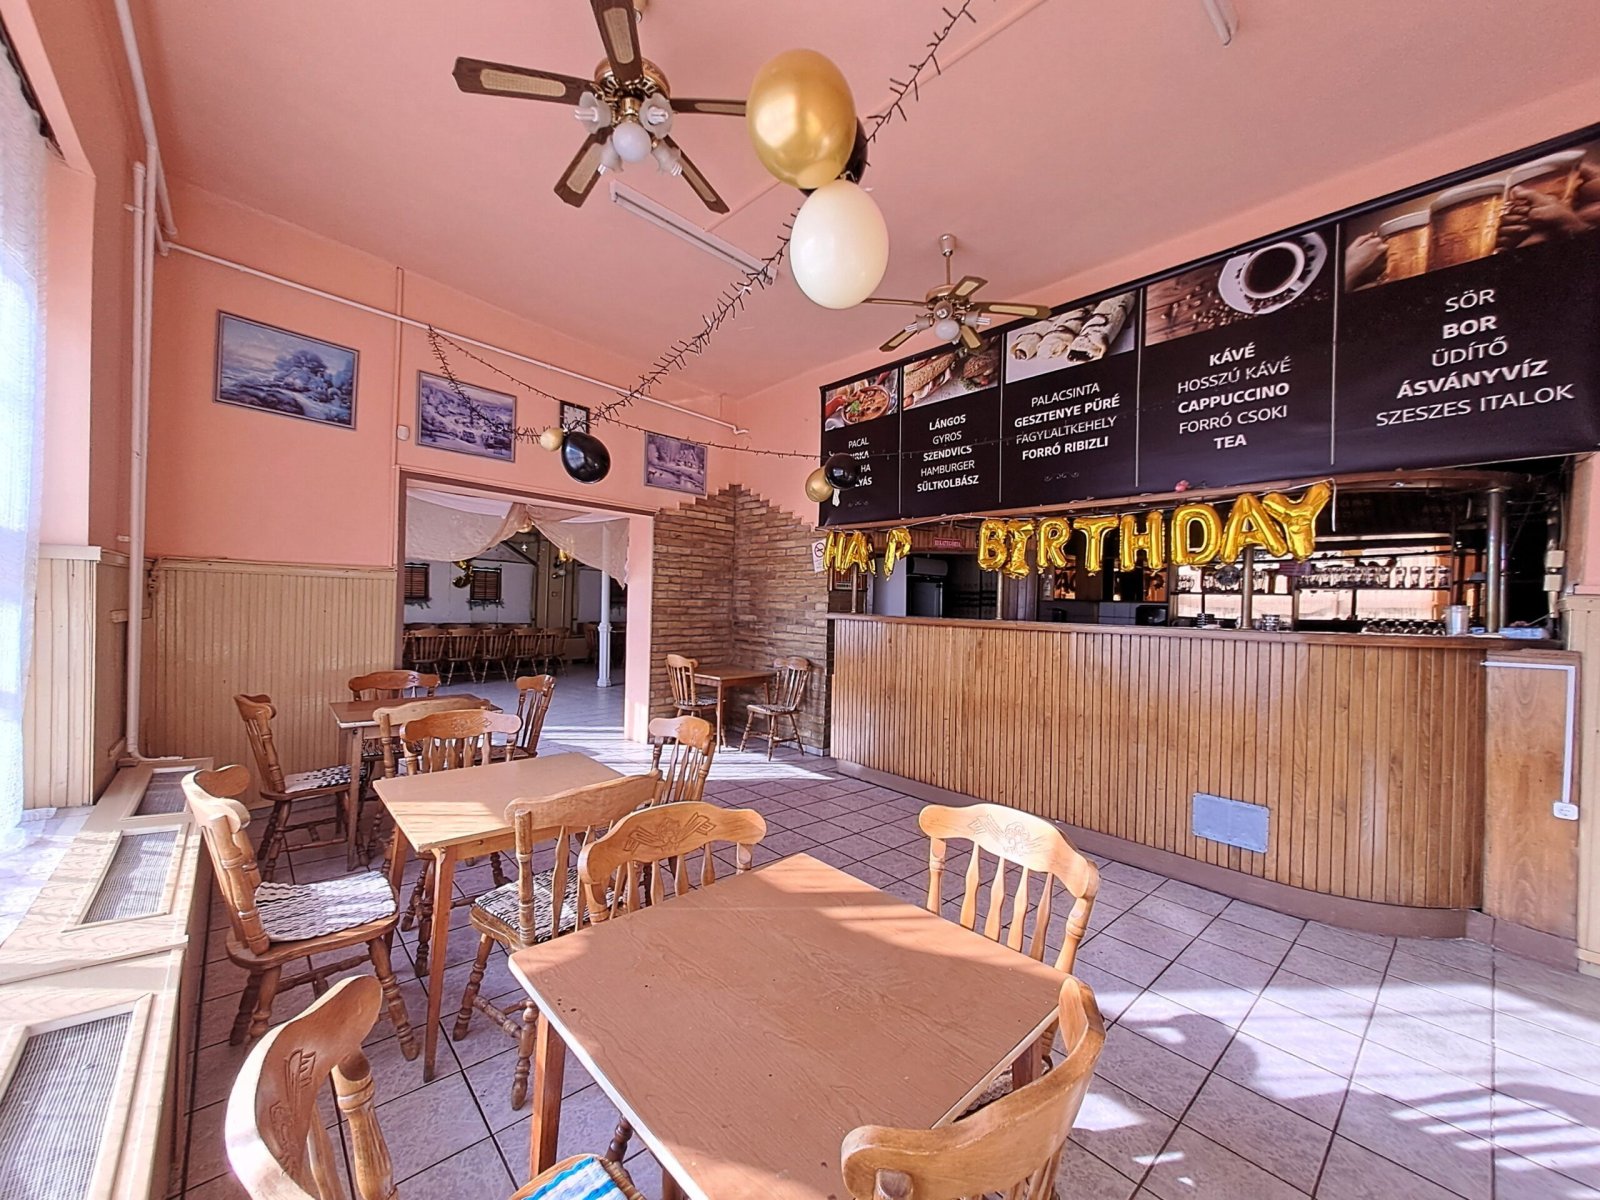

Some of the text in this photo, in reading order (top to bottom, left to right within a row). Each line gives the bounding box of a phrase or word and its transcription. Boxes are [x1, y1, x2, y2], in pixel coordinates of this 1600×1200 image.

[1445, 289, 1496, 312] SÖR
[1442, 315, 1497, 339] BOR
[1209, 342, 1256, 366] KÁVÉ
[1431, 336, 1508, 367] ÜDÍTŐ
[1177, 356, 1292, 394] HOSSZÚ KÁVÉ
[1396, 360, 1549, 399] ÁSVÁNYVÍZ
[1031, 382, 1100, 407] PALACSINTA
[1177, 382, 1290, 414] CAPPUCCINO
[1375, 383, 1575, 427] SZESZES ITALOK
[929, 414, 966, 431] LÁNGOS
[1014, 403, 1081, 428] GESZTENYE
[1178, 405, 1288, 434] FORRÓ CSOKI
[932, 431, 962, 444] GYROS
[1016, 416, 1117, 444] FAGYLALTKEHELY
[1214, 434, 1247, 449] TEA
[848, 437, 869, 449] PACAL
[923, 445, 972, 461] SZENDVICS
[1022, 436, 1109, 460] FORRÓ RIBIZLI
[920, 459, 975, 476] HAMBURGER
[917, 474, 979, 492] SÜLTKOLBÁSZ
[979, 483, 1331, 577] BIRTHDAY
